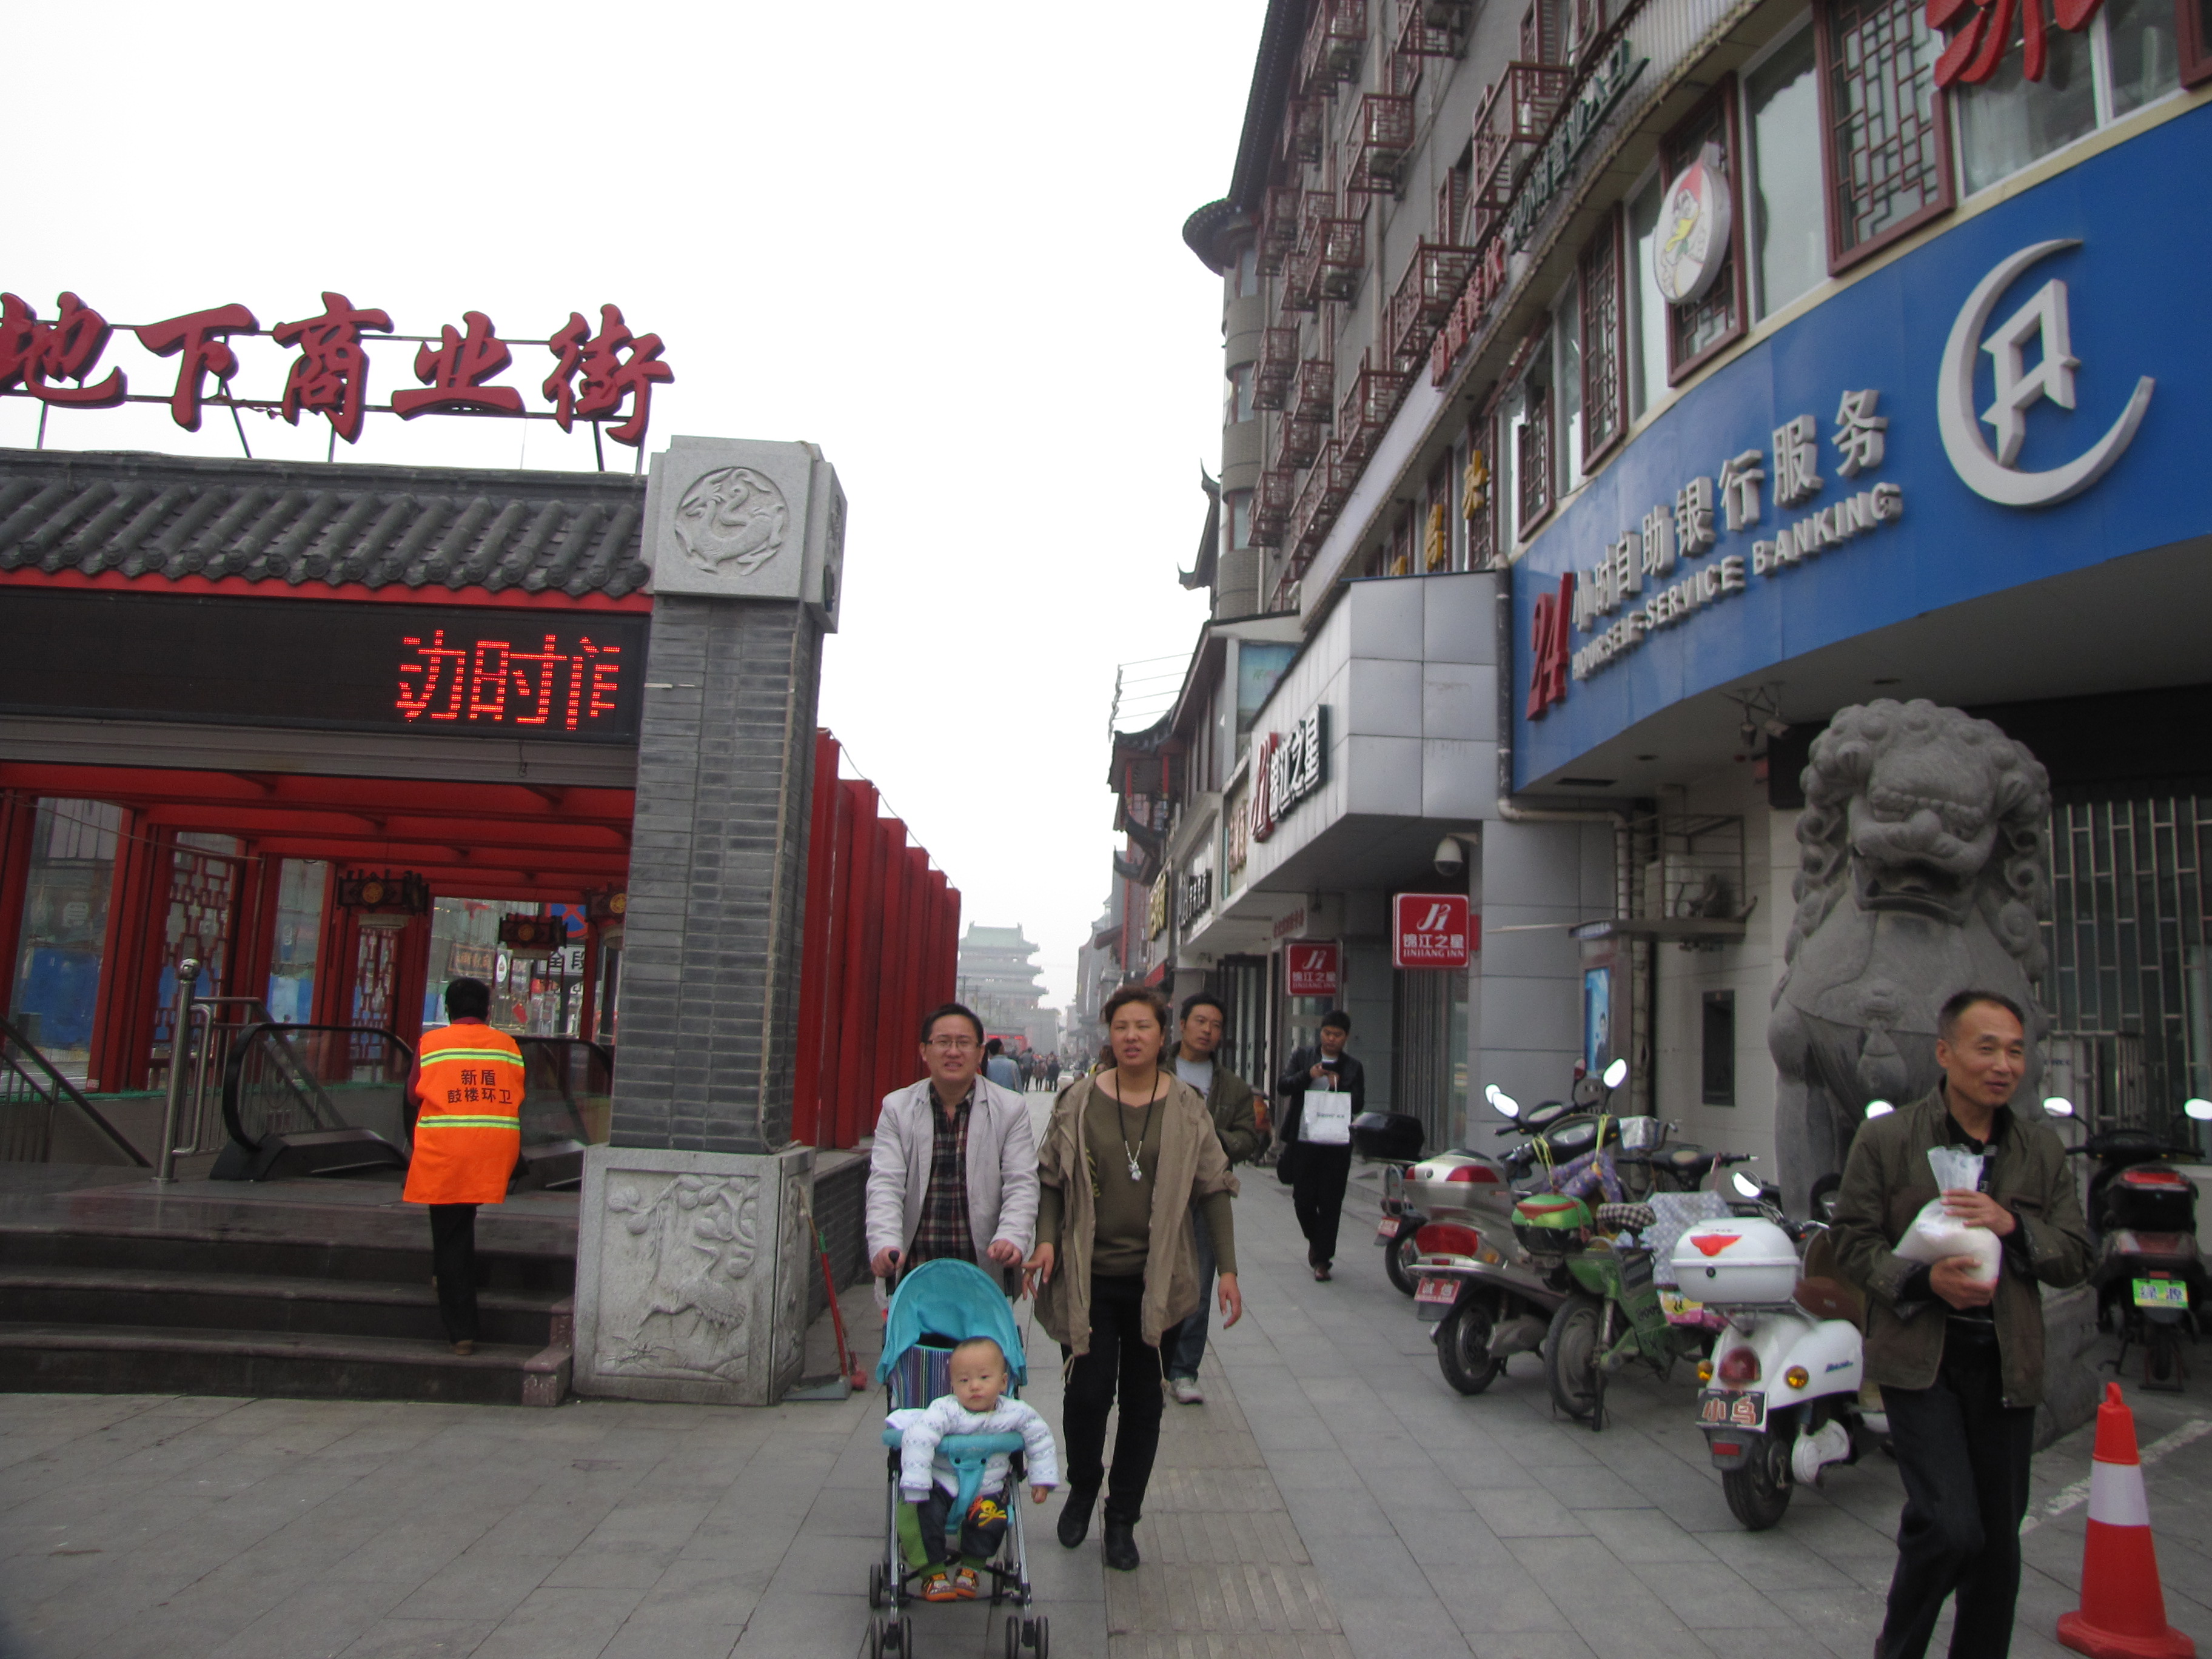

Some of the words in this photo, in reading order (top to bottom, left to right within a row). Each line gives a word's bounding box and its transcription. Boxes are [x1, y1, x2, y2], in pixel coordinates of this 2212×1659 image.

[0, 291, 674, 446] 地下商业街
[1572, 389, 1889, 632] 小时自助银行服务
[1752, 482, 1902, 575] BANKING
[1526, 572, 1574, 720] 24
[1403, 933, 1464, 948] 锦江之星
[1403, 948, 1444, 957] JINJIANG
[447, 1087, 512, 1104] 鼓楼环卫
[461, 1069, 496, 1086] 新盾
